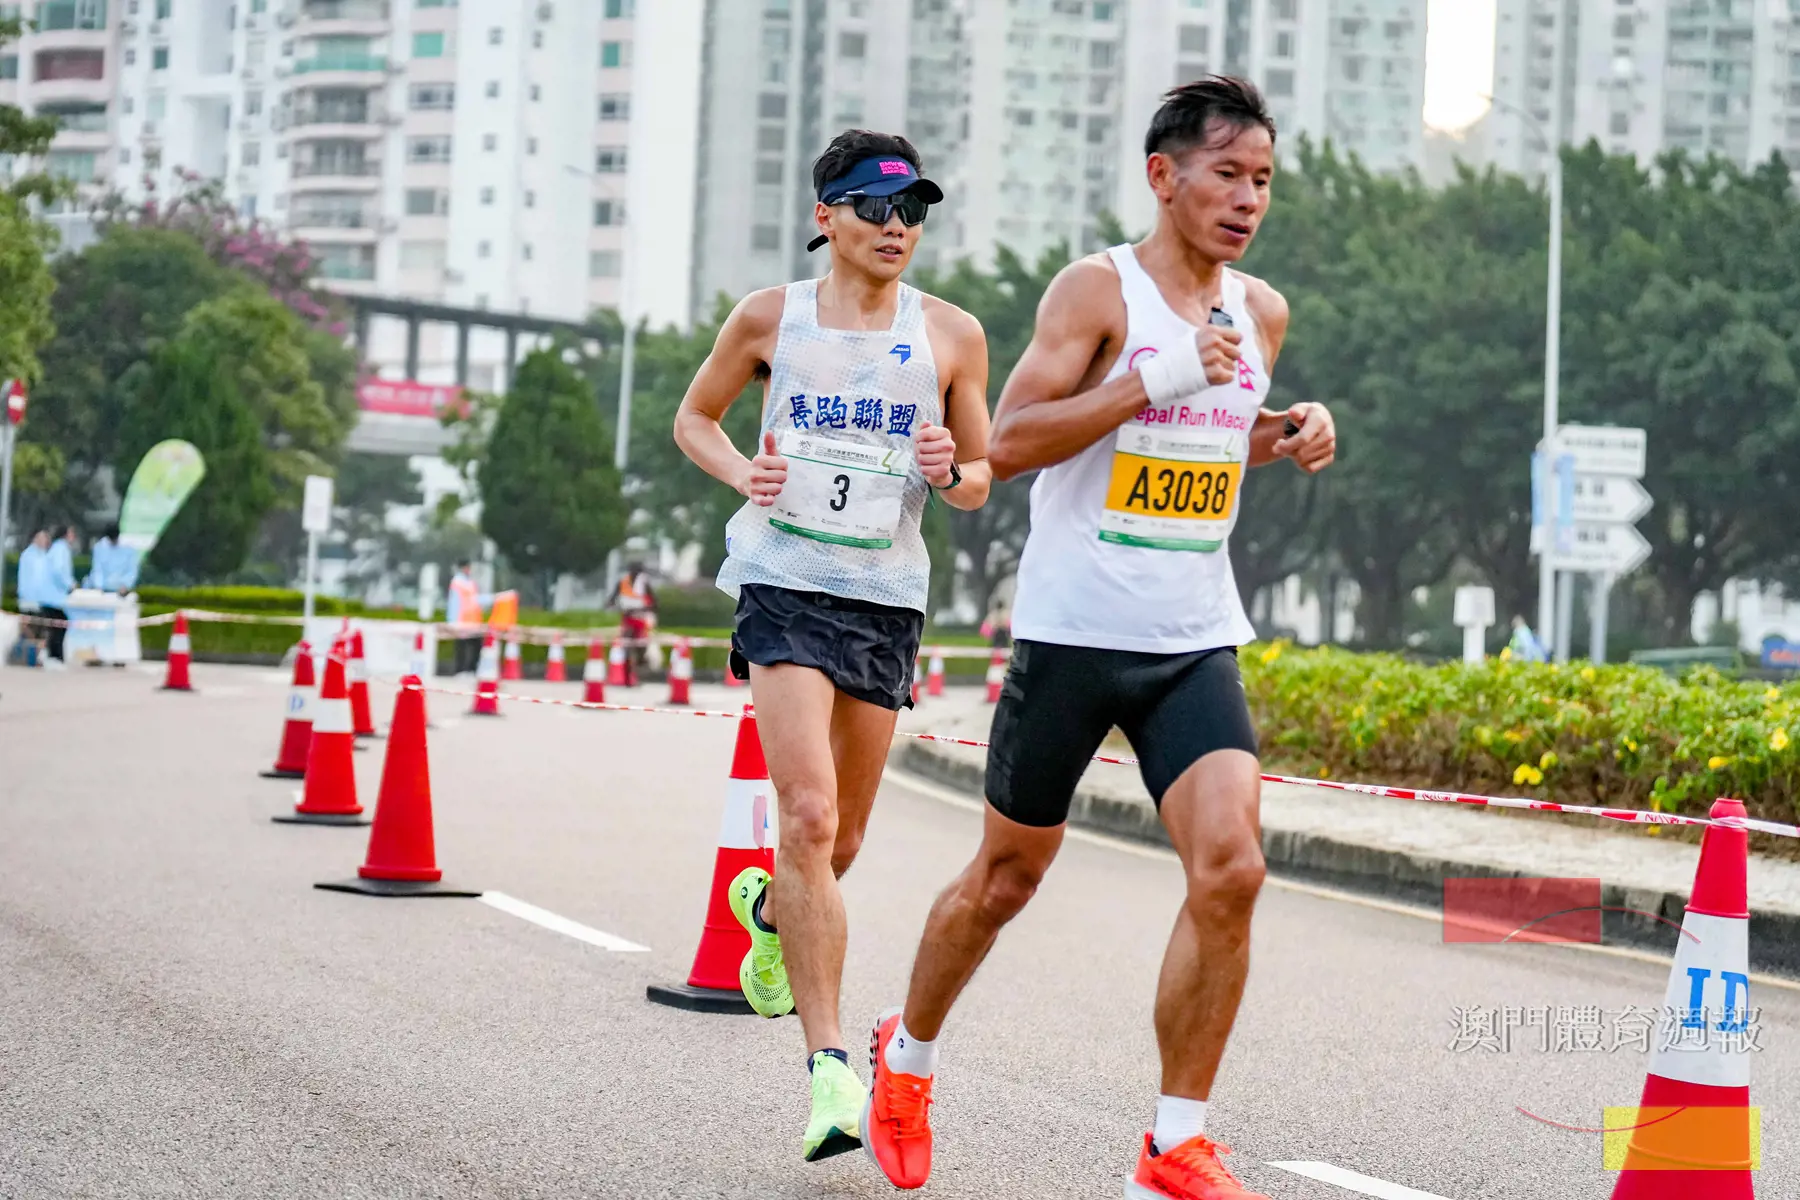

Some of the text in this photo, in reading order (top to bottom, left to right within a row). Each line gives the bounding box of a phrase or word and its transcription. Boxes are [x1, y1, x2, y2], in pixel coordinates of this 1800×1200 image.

[789, 394, 916, 437] 長跑聯盟
[1135, 404, 1175, 426] epal
[1178, 406, 1206, 427] Run
[829, 474, 850, 512] 3
[1125, 465, 1229, 514] A3038
[1681, 967, 1749, 1033] ID
